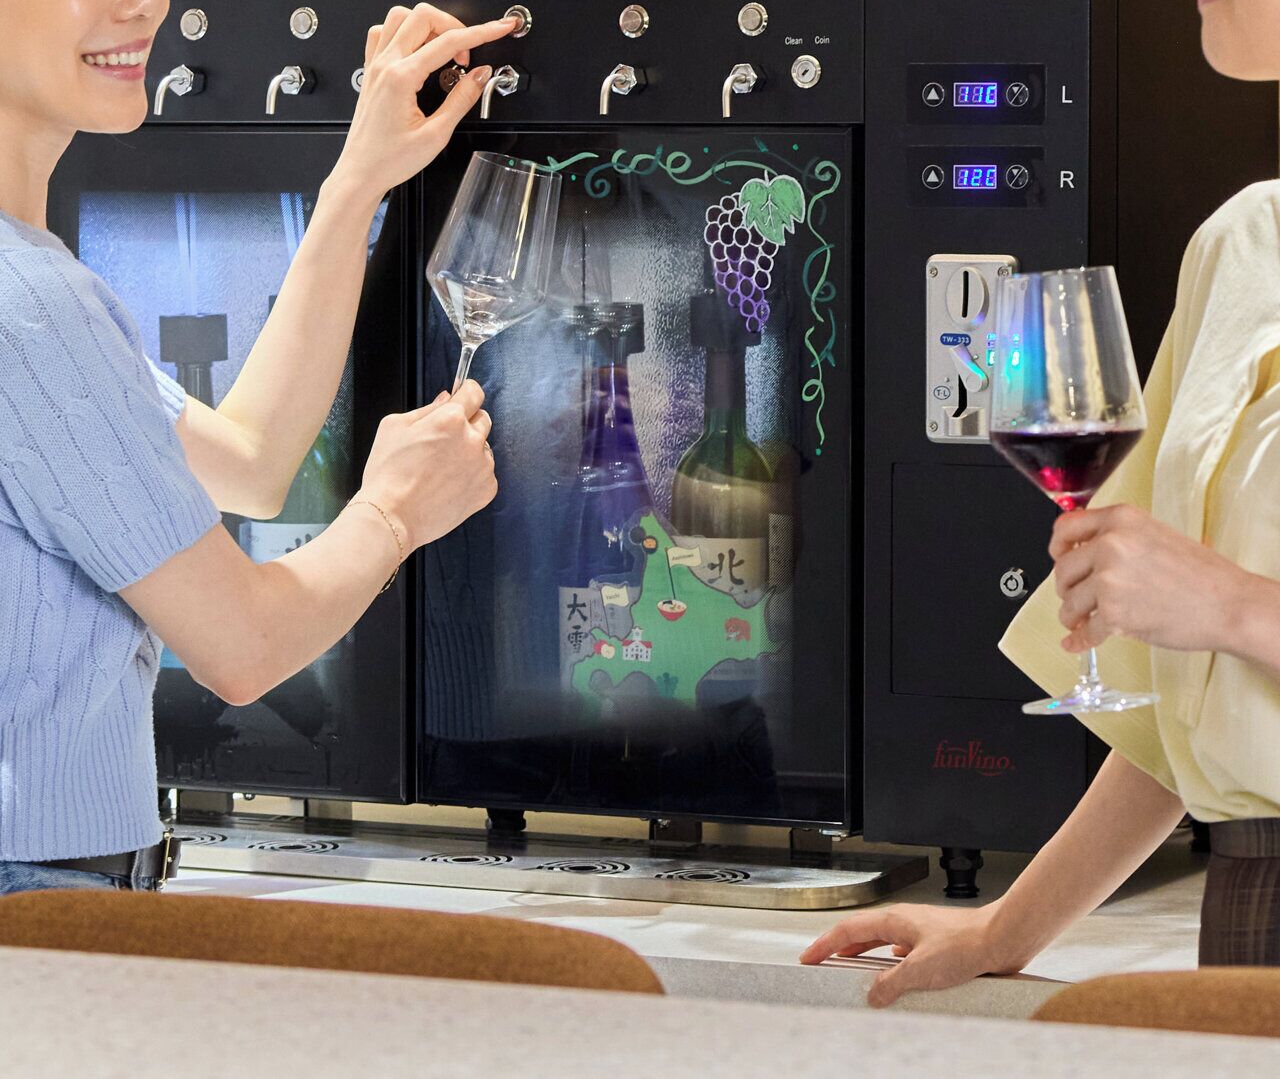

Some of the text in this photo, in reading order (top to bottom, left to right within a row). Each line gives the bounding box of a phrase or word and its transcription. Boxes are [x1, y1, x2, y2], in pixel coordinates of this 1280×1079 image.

[785, 35, 830, 46] Clean Coin
[1061, 85, 1073, 104] L
[961, 168, 996, 187] 12C
[1059, 170, 1074, 189] R
[706, 548, 746, 586] 北
